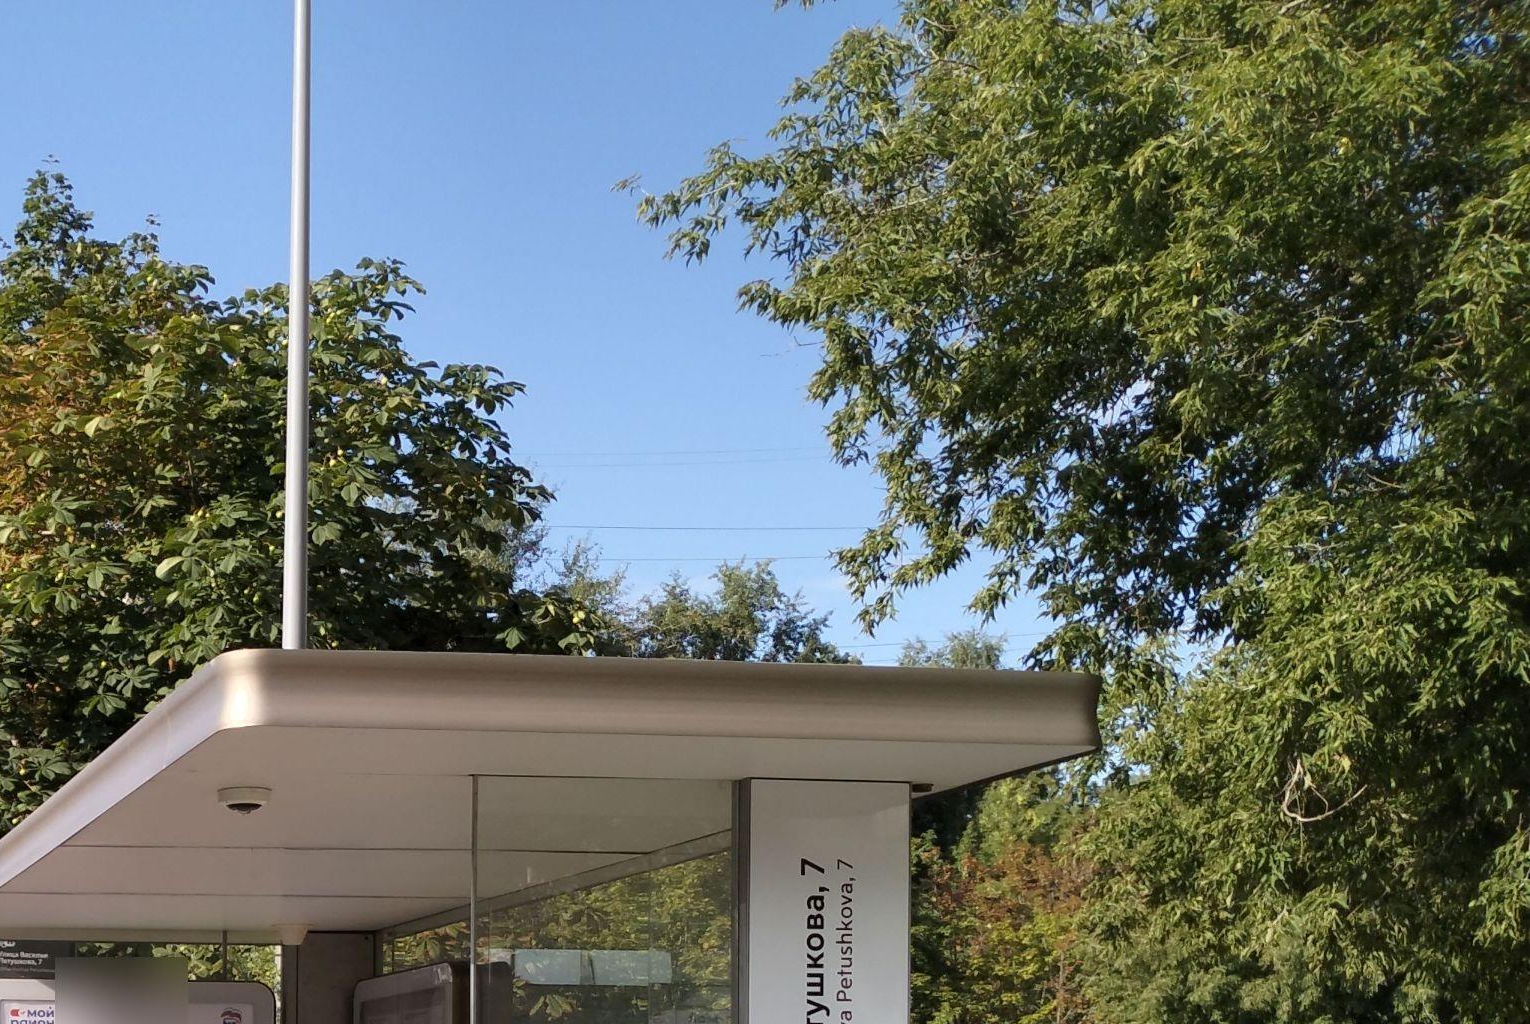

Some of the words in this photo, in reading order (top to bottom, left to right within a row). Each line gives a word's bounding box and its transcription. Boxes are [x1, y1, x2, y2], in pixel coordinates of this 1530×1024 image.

[800, 857, 825, 876] 7
[837, 858, 854, 870] 7
[836, 877, 856, 1002] Petushkova,
